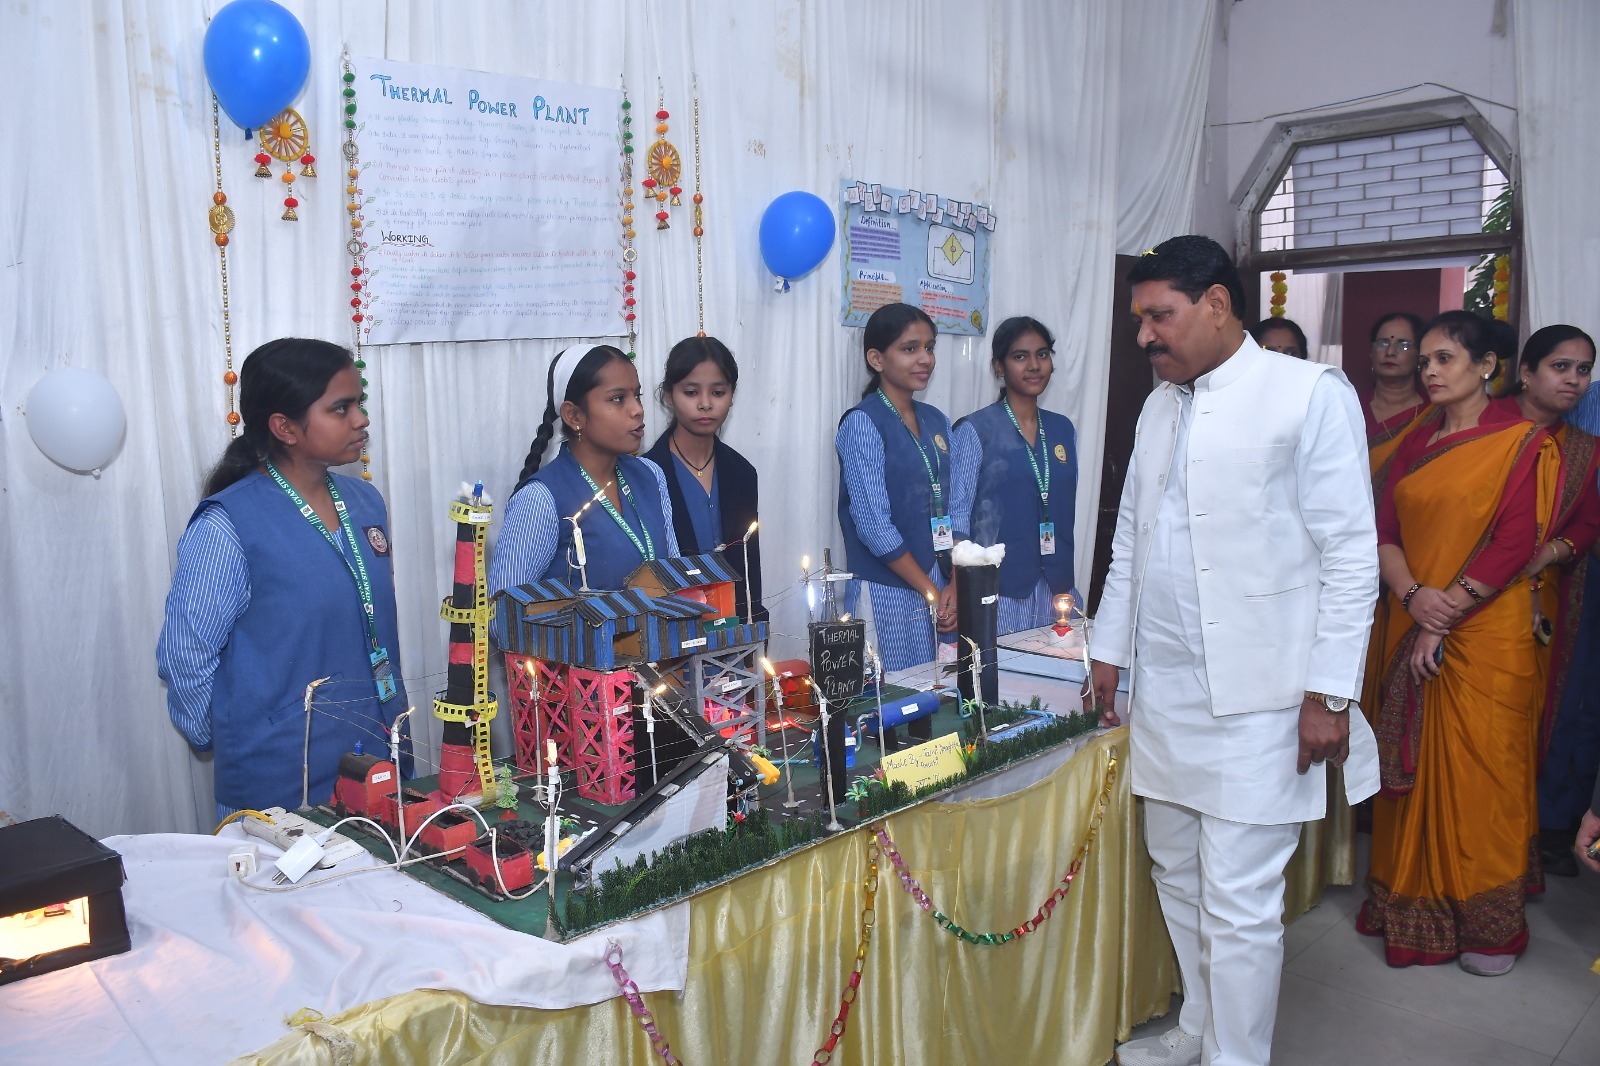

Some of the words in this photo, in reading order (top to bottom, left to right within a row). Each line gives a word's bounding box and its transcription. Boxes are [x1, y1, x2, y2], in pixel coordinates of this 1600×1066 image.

[370, 73, 453, 105] THERMAL
[468, 89, 518, 118] POWER
[533, 95, 590, 125] PLANT
[380, 229, 429, 244] WORKING
[286, 487, 303, 505] GYAN
[818, 627, 860, 645] THERMAL
[820, 649, 860, 672] POWER
[824, 675, 858, 697] PLANT
[886, 758, 908, 771] Made
